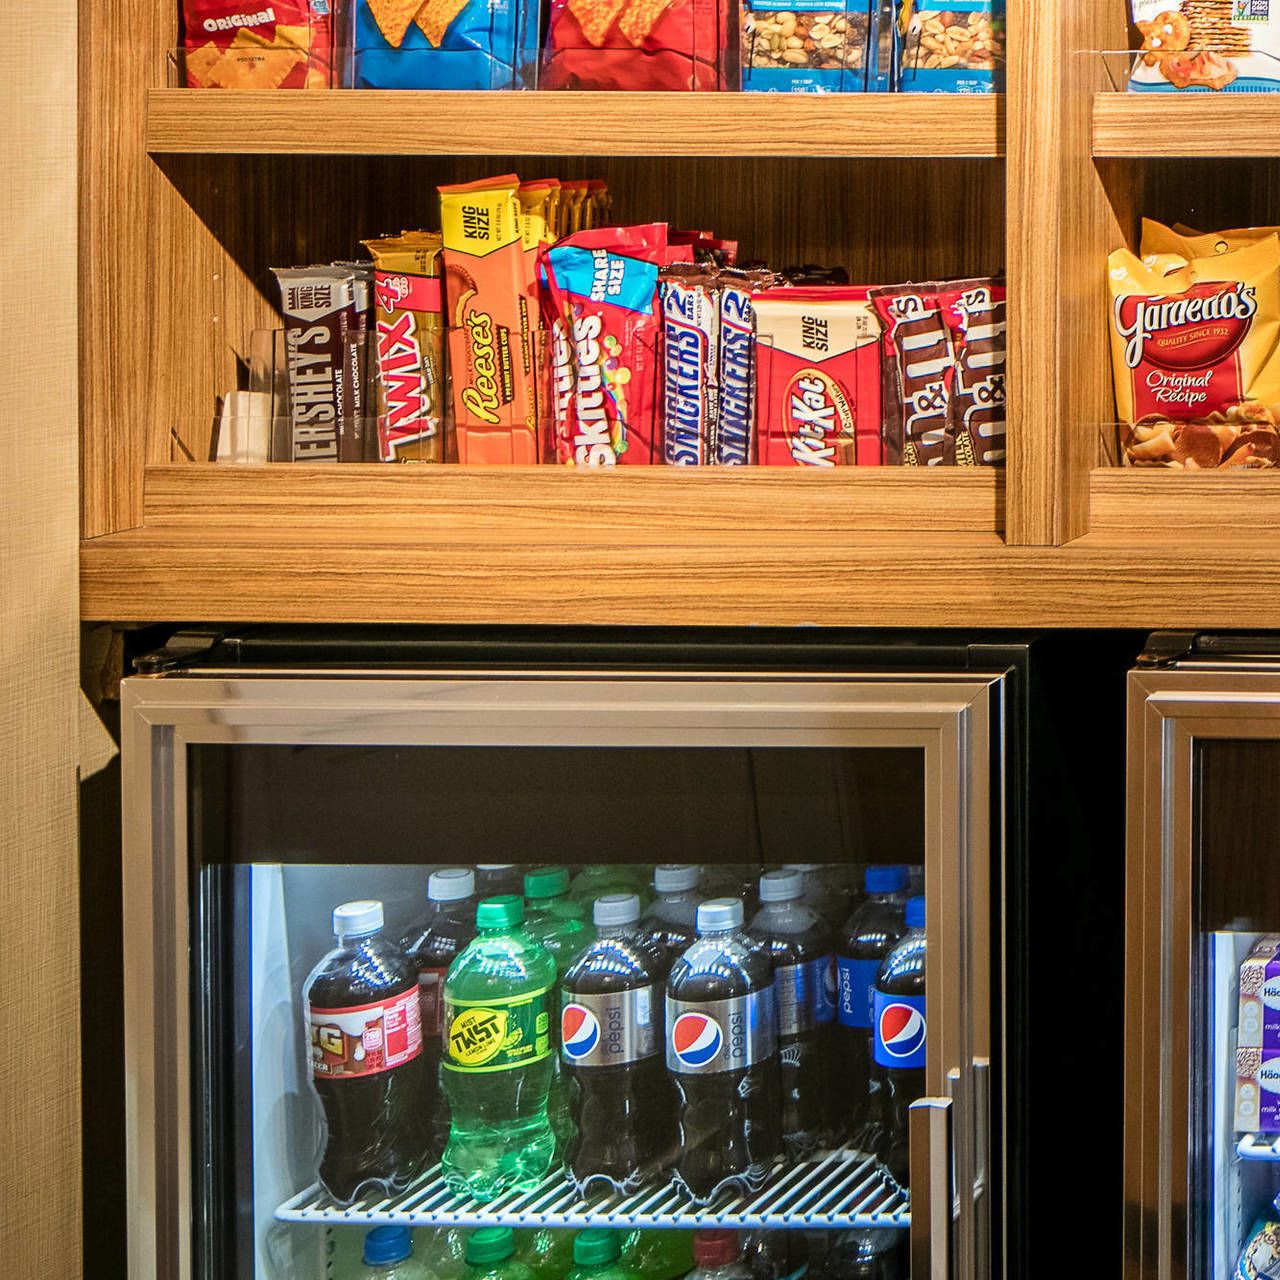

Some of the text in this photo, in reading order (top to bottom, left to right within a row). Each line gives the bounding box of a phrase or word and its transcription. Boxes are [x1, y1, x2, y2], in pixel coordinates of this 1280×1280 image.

[461, 204, 478, 239] KING
[477, 206, 491, 241] SIZE
[589, 248, 608, 302] SHARE
[606, 259, 625, 296] SIZE
[299, 286, 314, 310] KING
[314, 284, 332, 309] SIZE
[667, 289, 687, 318] 2
[686, 294, 694, 321] BARS
[725, 291, 746, 320] 2
[801, 315, 817, 350] KING
[815, 318, 829, 352] SIZE
[1157, 326, 1230, 348] QUALITY SINCE 1932
[461, 309, 501, 425] Reese's
[1145, 369, 1214, 393] Original
[376, 313, 432, 461] TWIX
[1151, 386, 1208, 408] Recipe
[841, 966, 852, 1015] pepsi
[606, 1006, 623, 1056] pepsi
[729, 1009, 747, 1059] pepsi
[1264, 1023, 1280, 1031] milk
[1261, 1105, 1277, 1114] milk
